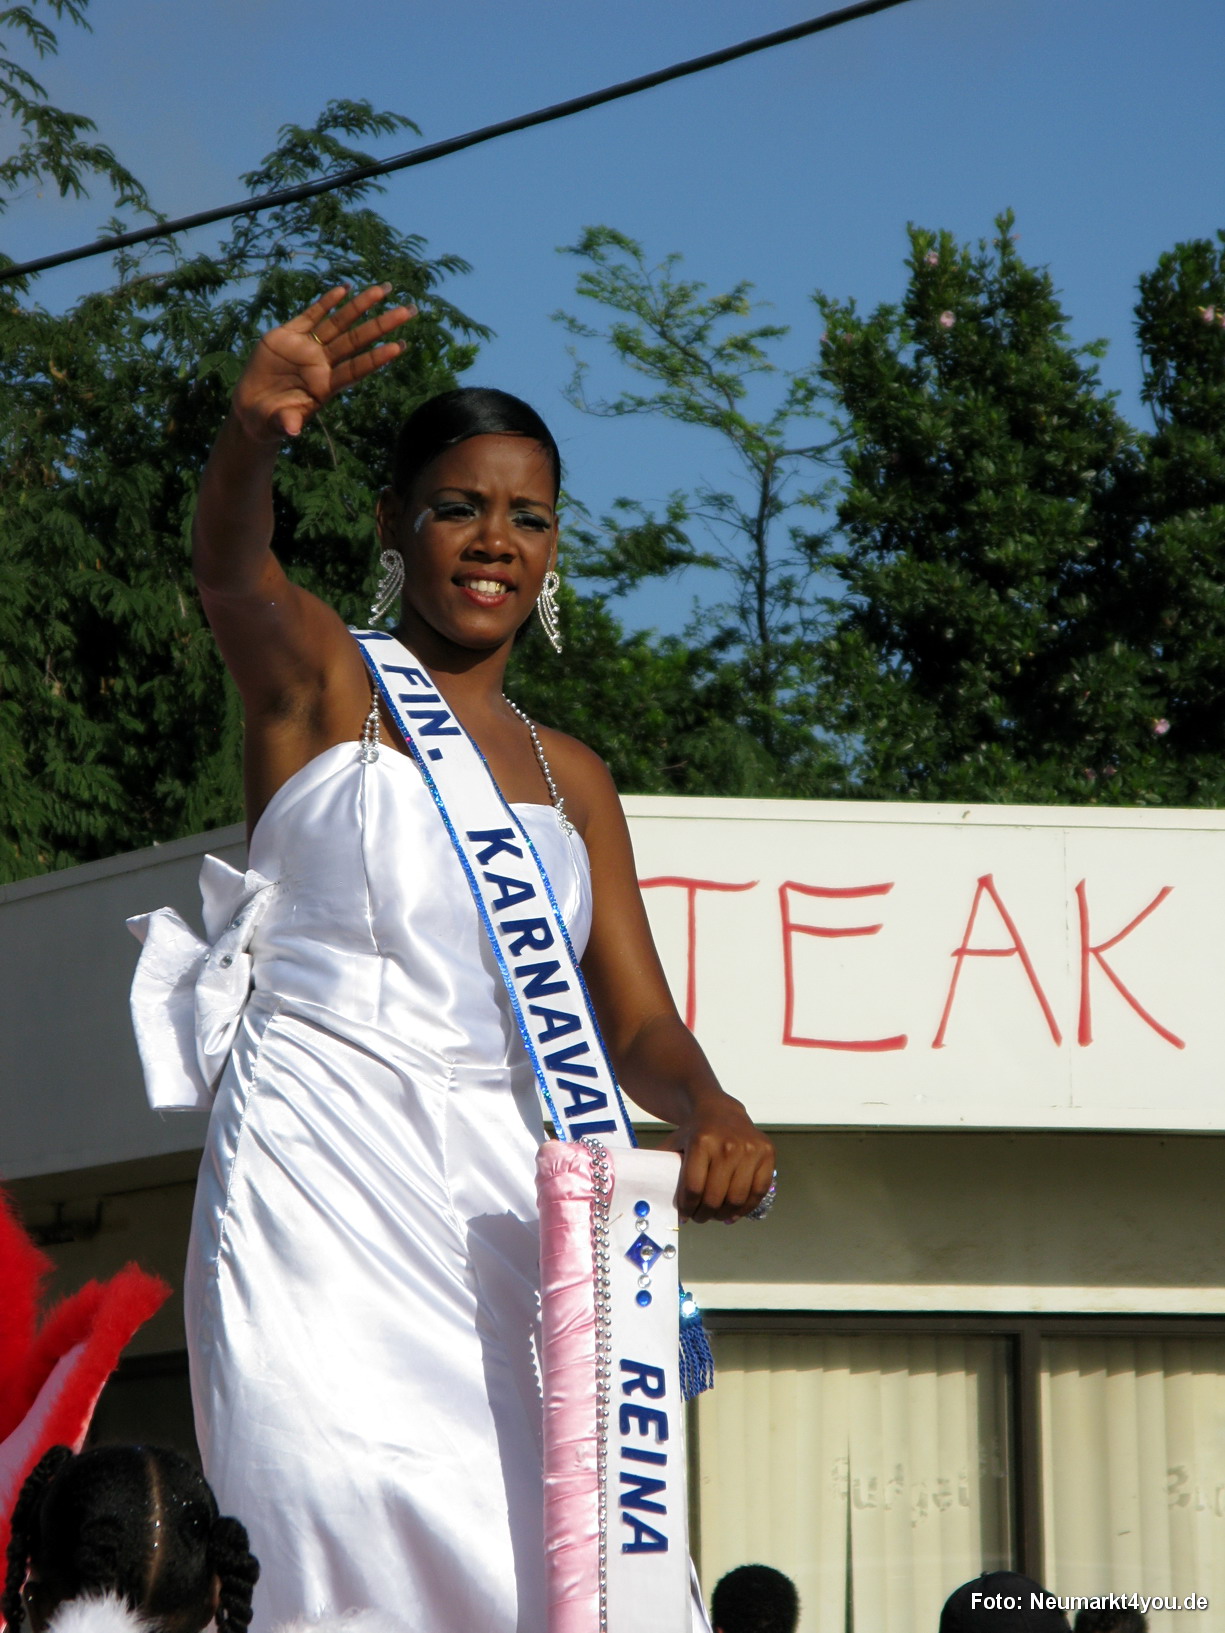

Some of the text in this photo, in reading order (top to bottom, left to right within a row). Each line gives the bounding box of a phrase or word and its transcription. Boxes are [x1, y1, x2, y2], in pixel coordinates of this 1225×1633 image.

[380, 663, 617, 1143] FIN. KARNAVAL
[619, 1358, 669, 1555] REINA
